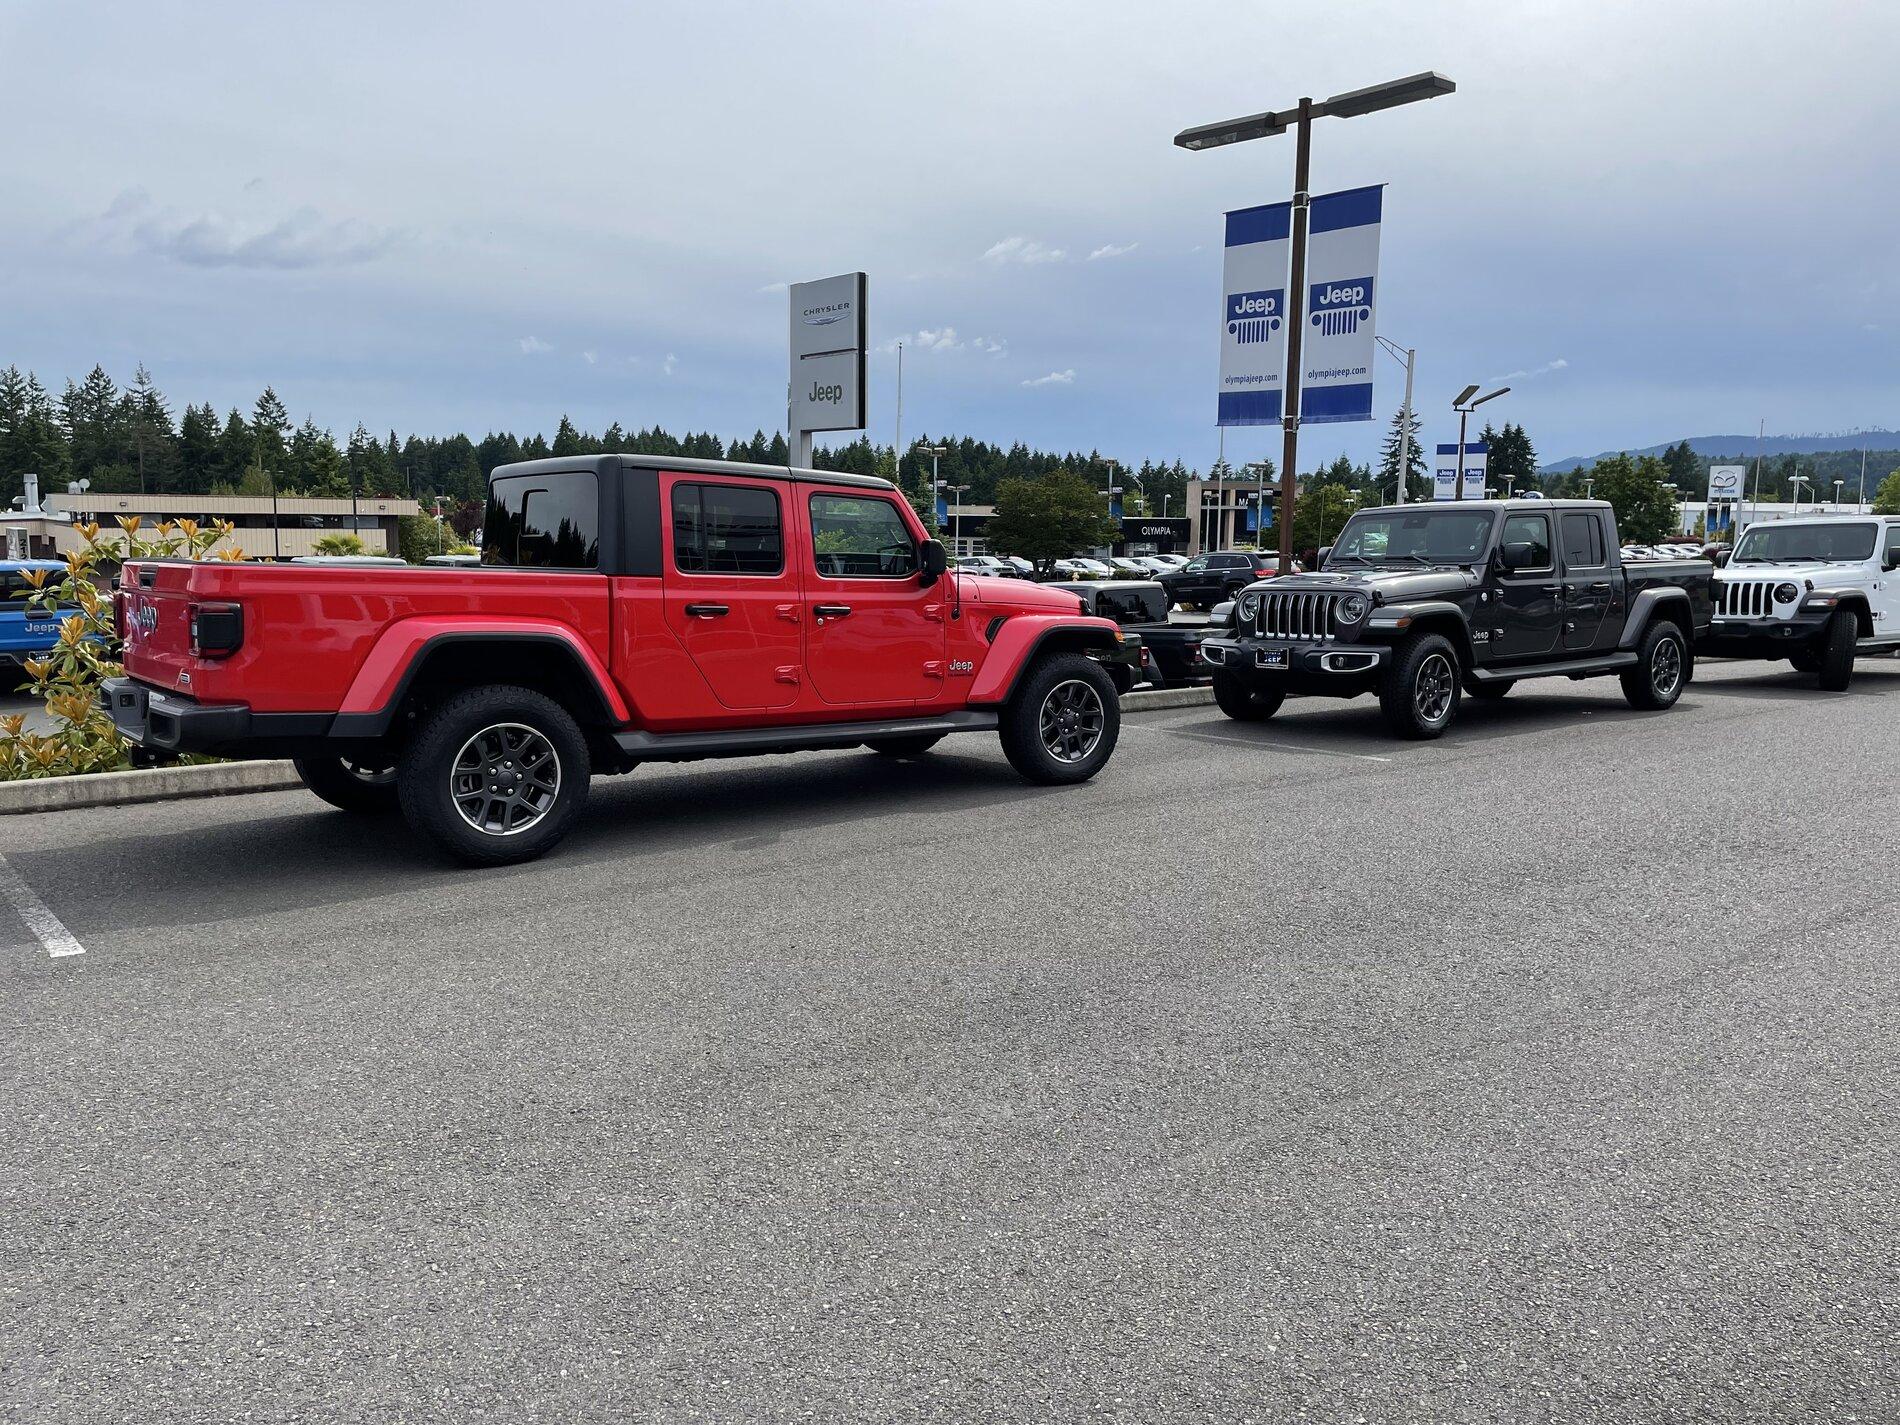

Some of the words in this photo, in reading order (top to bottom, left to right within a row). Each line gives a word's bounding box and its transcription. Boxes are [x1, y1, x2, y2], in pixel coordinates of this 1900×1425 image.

[1319, 285, 1363, 304] Jeep
[803, 302, 850, 317] CHRYSLER
[1234, 296, 1276, 315] Jeep
[1225, 373, 1278, 384] olympiajeep.com
[1308, 366, 1367, 379] olympiajeep.com
[808, 381, 843, 404] Jeep
[1439, 469, 1454, 477] Jeep
[1467, 469, 1482, 477] Jeep
[1141, 526, 1171, 536] OLYMPIA
[24, 622, 56, 633] Jeep
[1472, 630, 1489, 640] Jeep
[949, 659, 973, 672] Jeep
